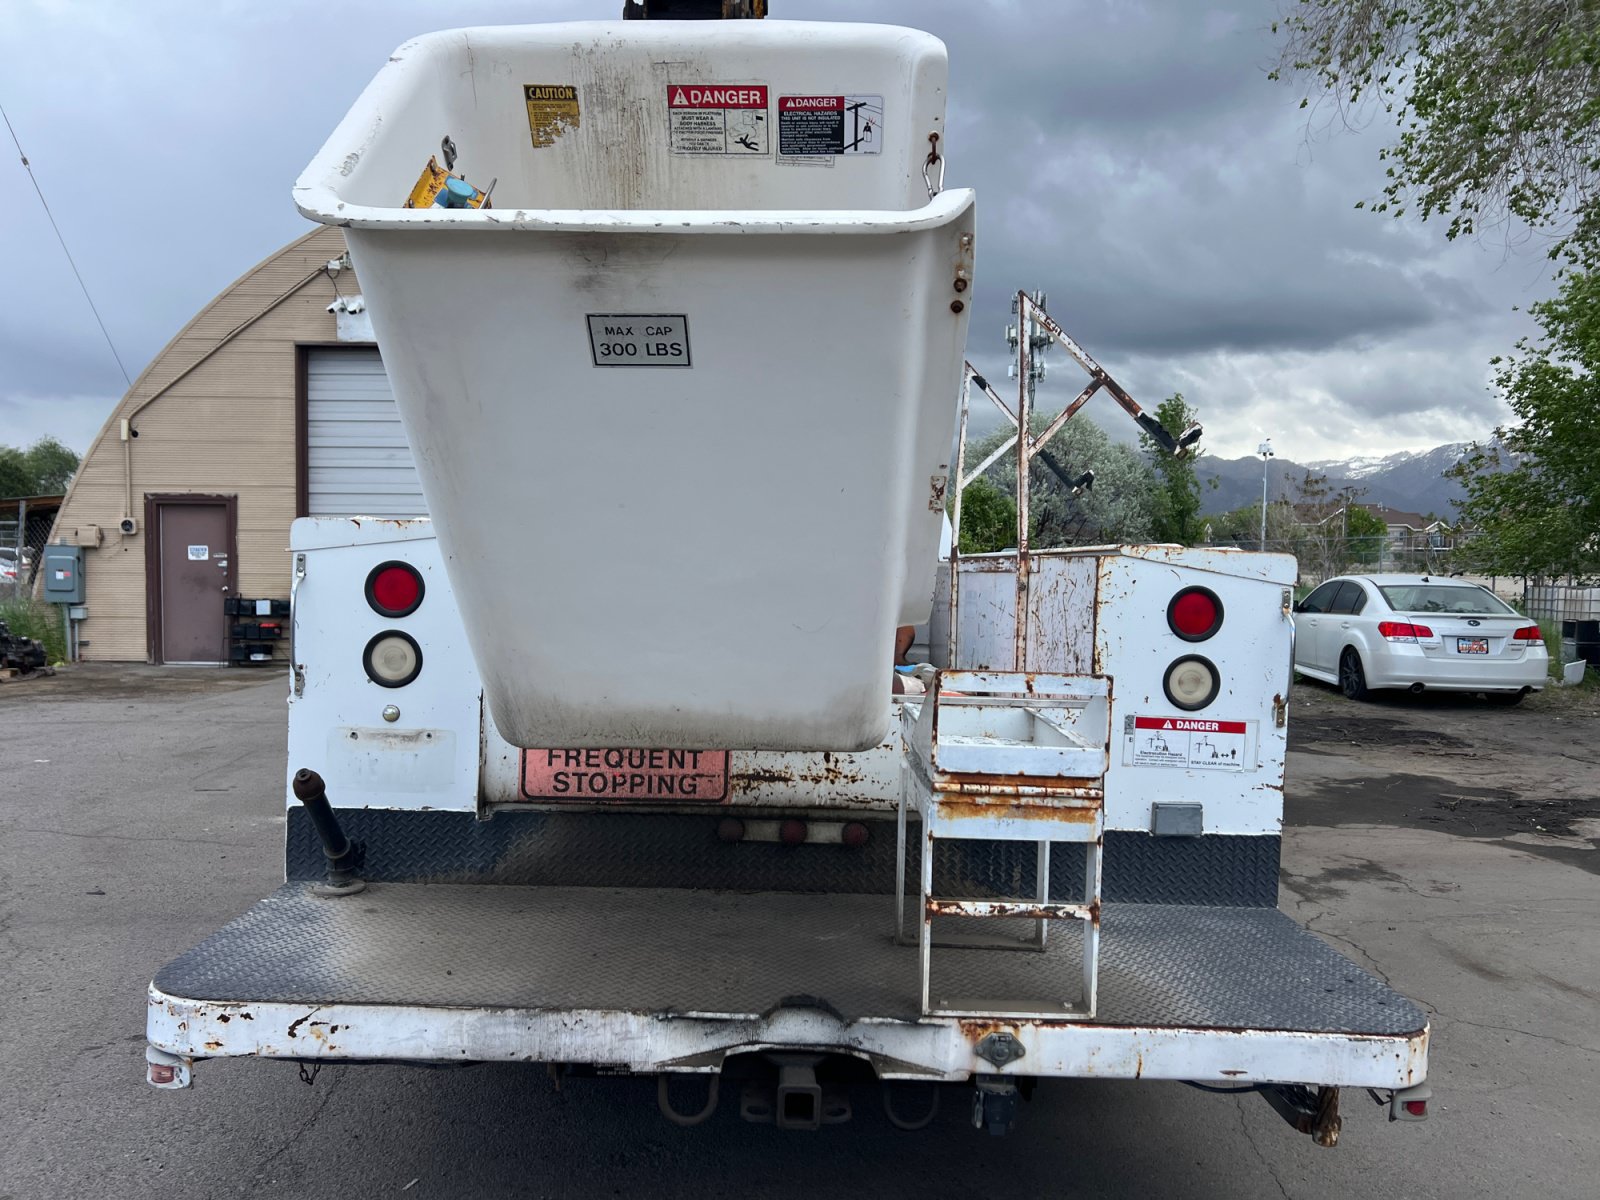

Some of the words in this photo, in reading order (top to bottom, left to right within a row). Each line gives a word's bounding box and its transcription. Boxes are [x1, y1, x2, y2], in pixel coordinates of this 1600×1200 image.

[528, 87, 573, 99] CAUTION
[690, 90, 761, 104] DANGER
[795, 98, 837, 107] DANGER
[605, 326, 634, 336] MAX
[645, 326, 673, 336] CAP
[599, 342, 637, 356] 300
[645, 342, 683, 357] LBS
[1176, 721, 1219, 731] DANGER
[547, 748, 704, 769] FREQUENT
[552, 771, 698, 795] STOPPING
